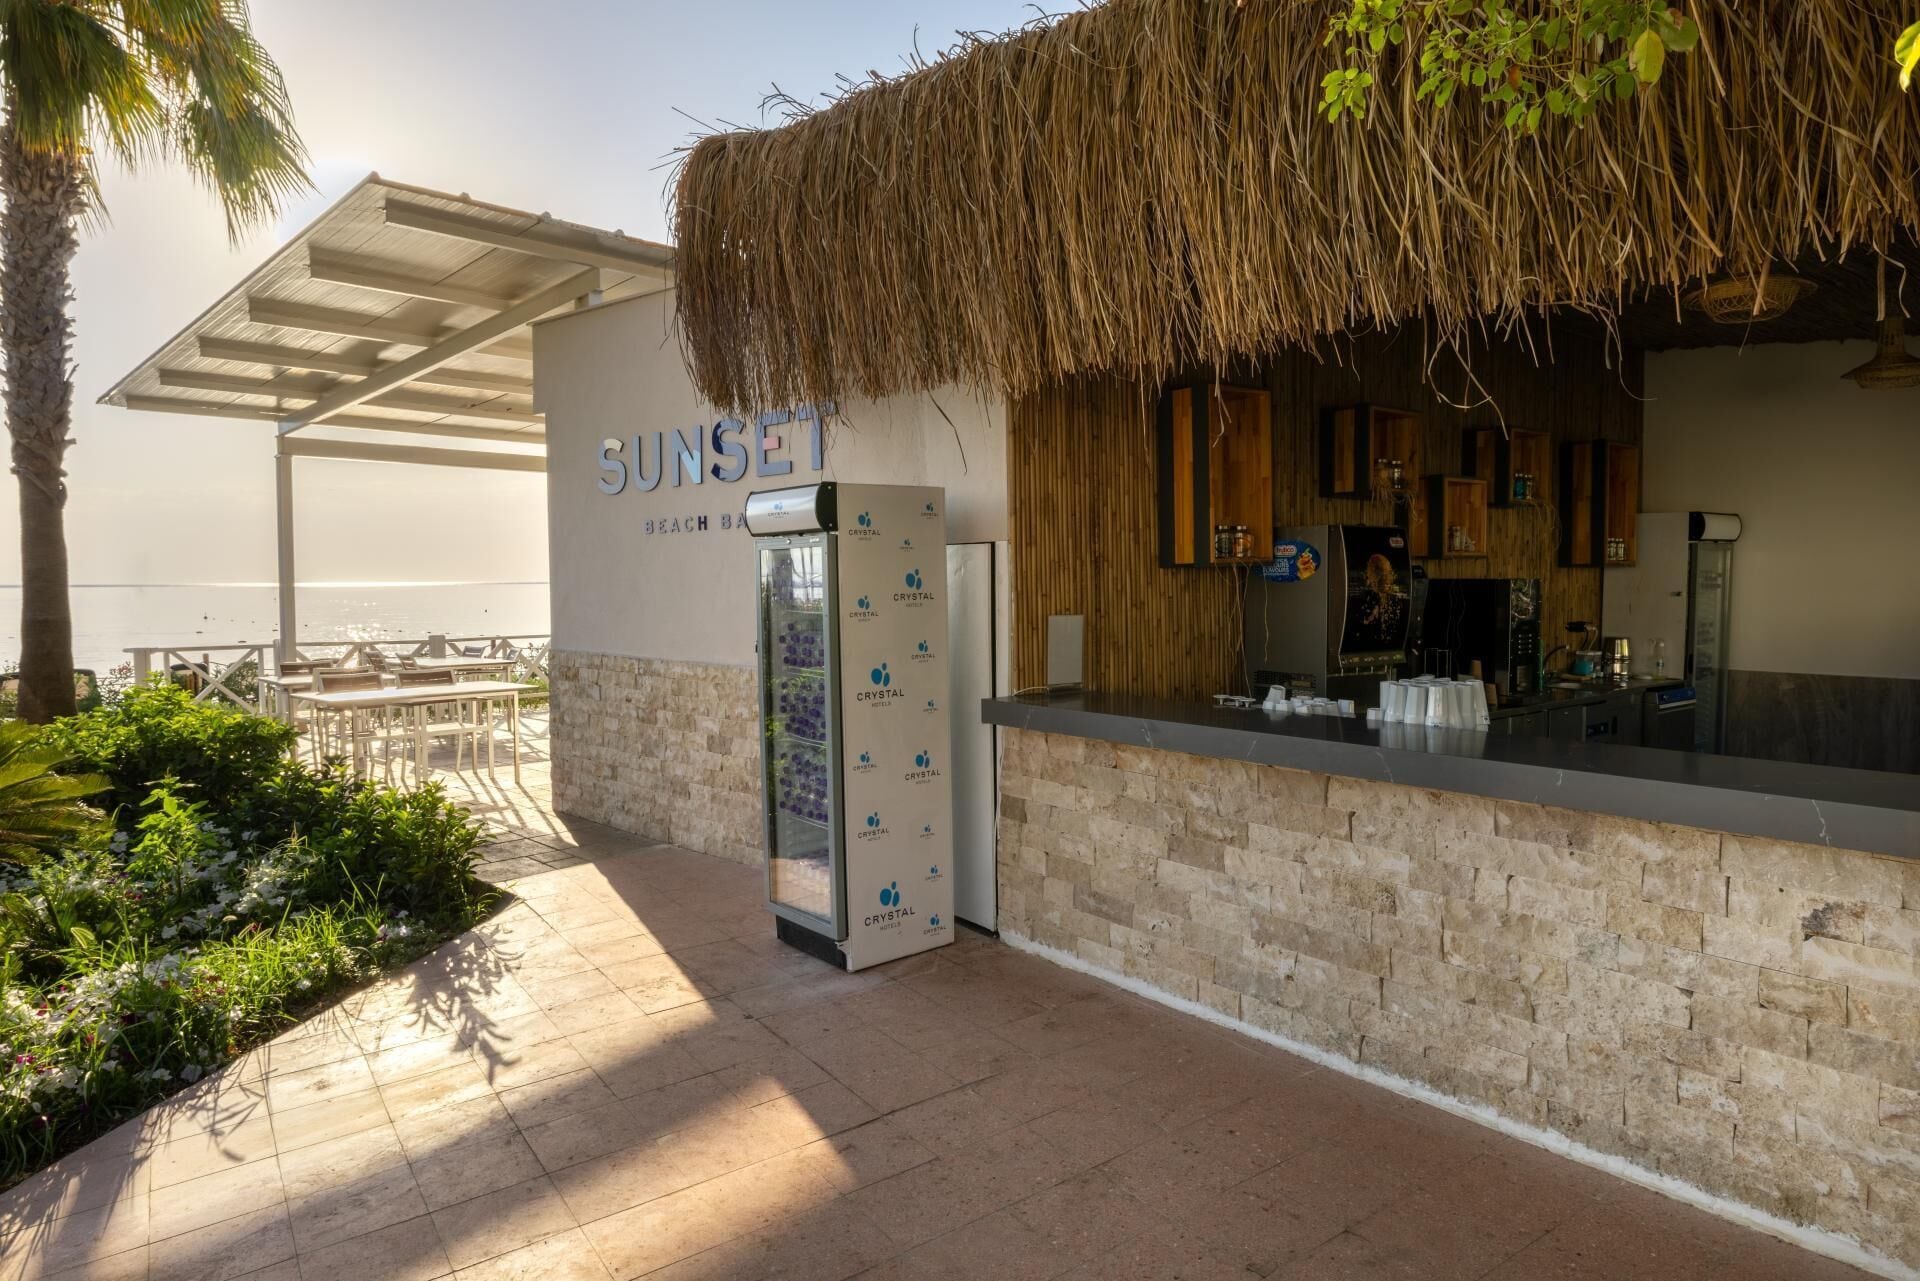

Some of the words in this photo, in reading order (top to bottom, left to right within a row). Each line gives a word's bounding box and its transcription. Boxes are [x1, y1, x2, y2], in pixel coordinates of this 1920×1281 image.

[598, 402, 836, 495] SUNSET
[644, 516, 708, 534] BEACH
[721, 513, 747, 530] BA
[893, 592, 935, 601] CRYSTAL
[856, 689, 905, 701] CRYSTAL
[905, 769, 941, 780] CRYSTAL
[857, 828, 889, 839] CRYSTAL
[864, 907, 916, 926] CRYSTAL
